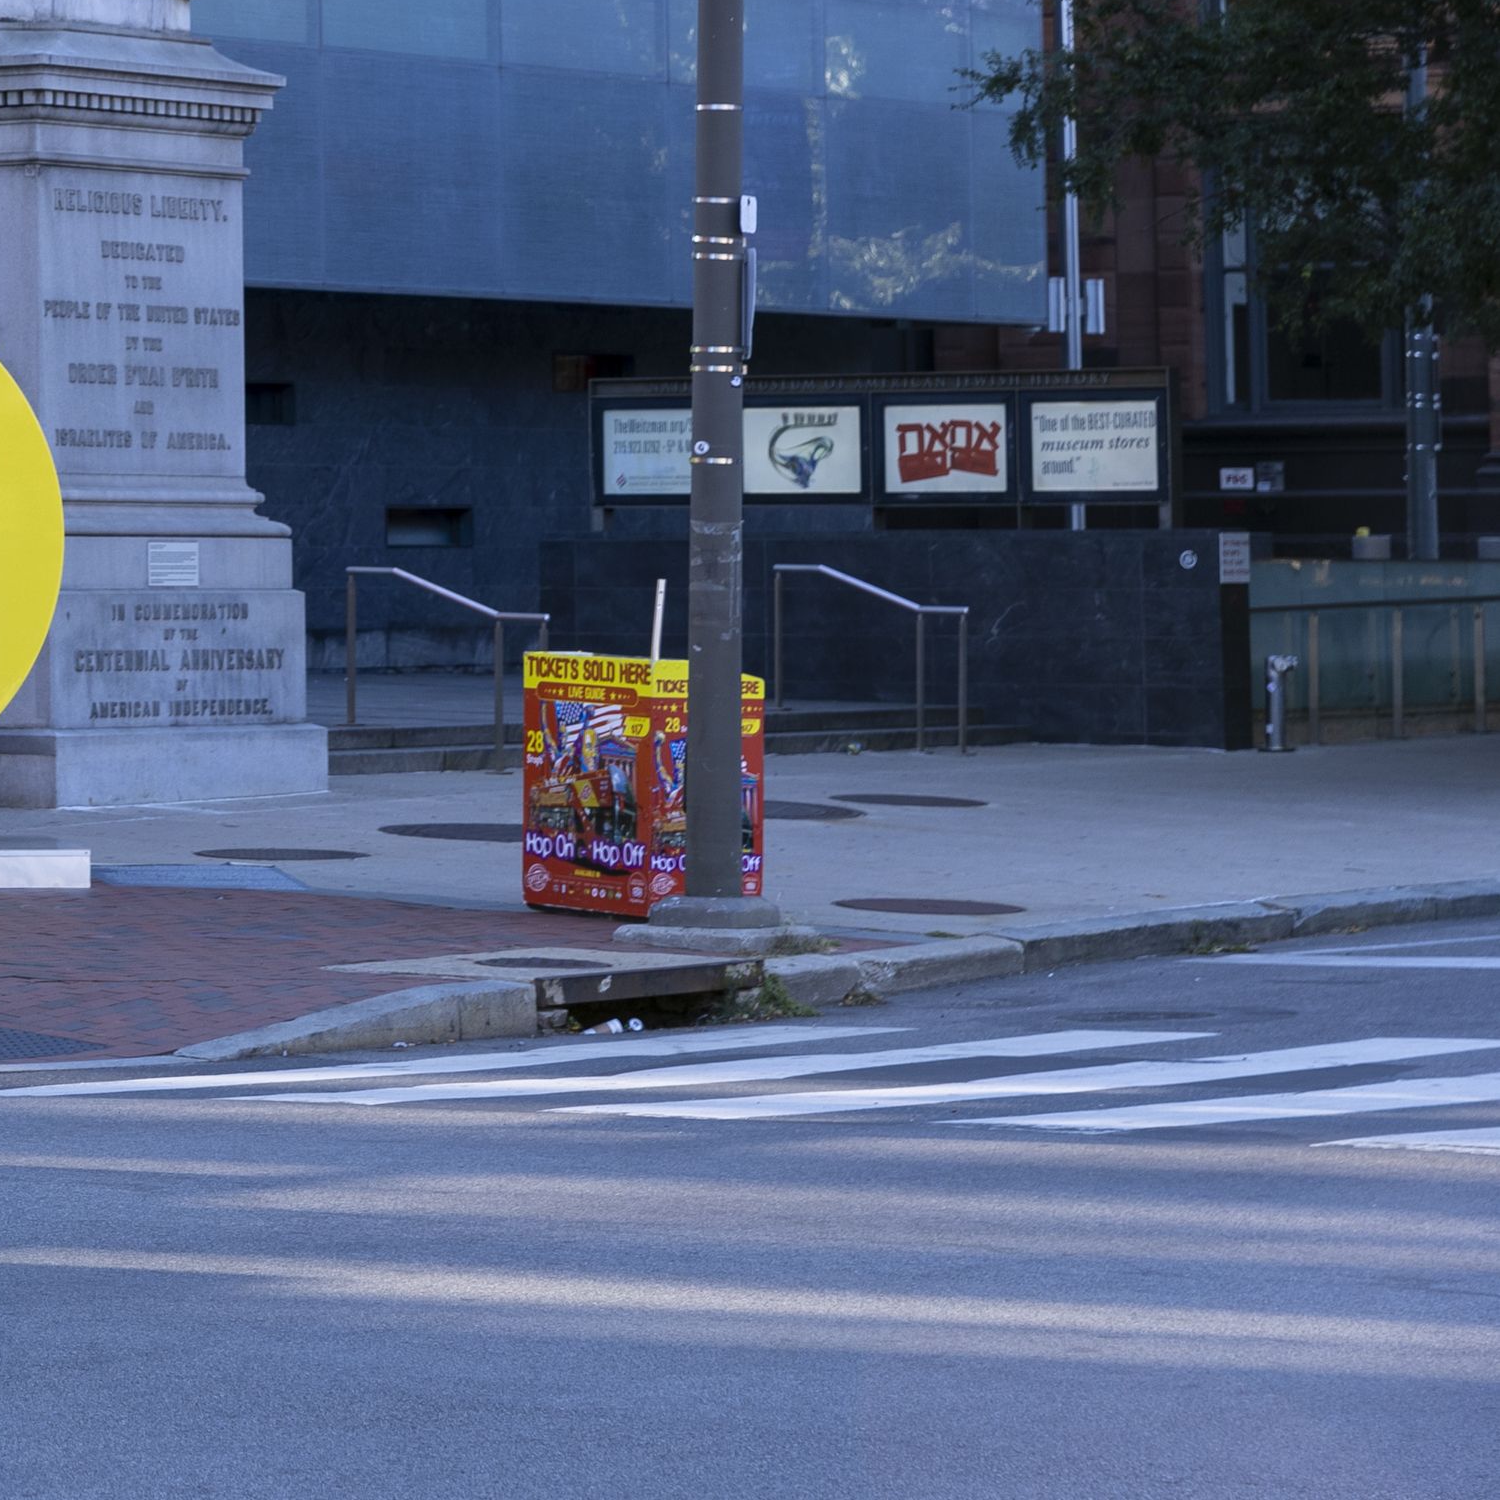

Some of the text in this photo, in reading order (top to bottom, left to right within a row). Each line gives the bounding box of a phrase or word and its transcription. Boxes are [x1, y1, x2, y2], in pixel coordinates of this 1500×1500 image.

[53, 188, 228, 223] RELIGIOUS LIBERTY.
[101, 240, 185, 263] DEDICATED
[124, 274, 163, 291] TO THE
[44, 300, 241, 327] PEOPLE OF THE UNITED STATES
[142, 337, 163, 352] THE
[68, 362, 118, 385] ORDER
[1071, 413, 1086, 431] the
[1087, 409, 1157, 431] BEST-CURATED
[55, 429, 132, 449] ISRAELITES
[141, 431, 158, 449] OF
[1041, 436, 1151, 452] museum stores
[133, 603, 249, 621] COMMEMORATION
[180, 628, 199, 641] THE
[74, 648, 286, 672] CENTENNIAL ANNIVERSARY
[527, 656, 652, 686] TICKETS SOLD HERE
[567, 686, 606, 700] LIVE GUIDE
[656, 679, 760, 695] TICKE ERE
[89, 700, 160, 719] AMERICAN
[665, 717, 681, 733] 28
[527, 730, 544, 753] 28
[526, 832, 553, 858] Hop
[555, 834, 575, 858] On
[592, 840, 620, 867] Hop
[622, 842, 646, 867] Off
[651, 855, 677, 873] Hop
